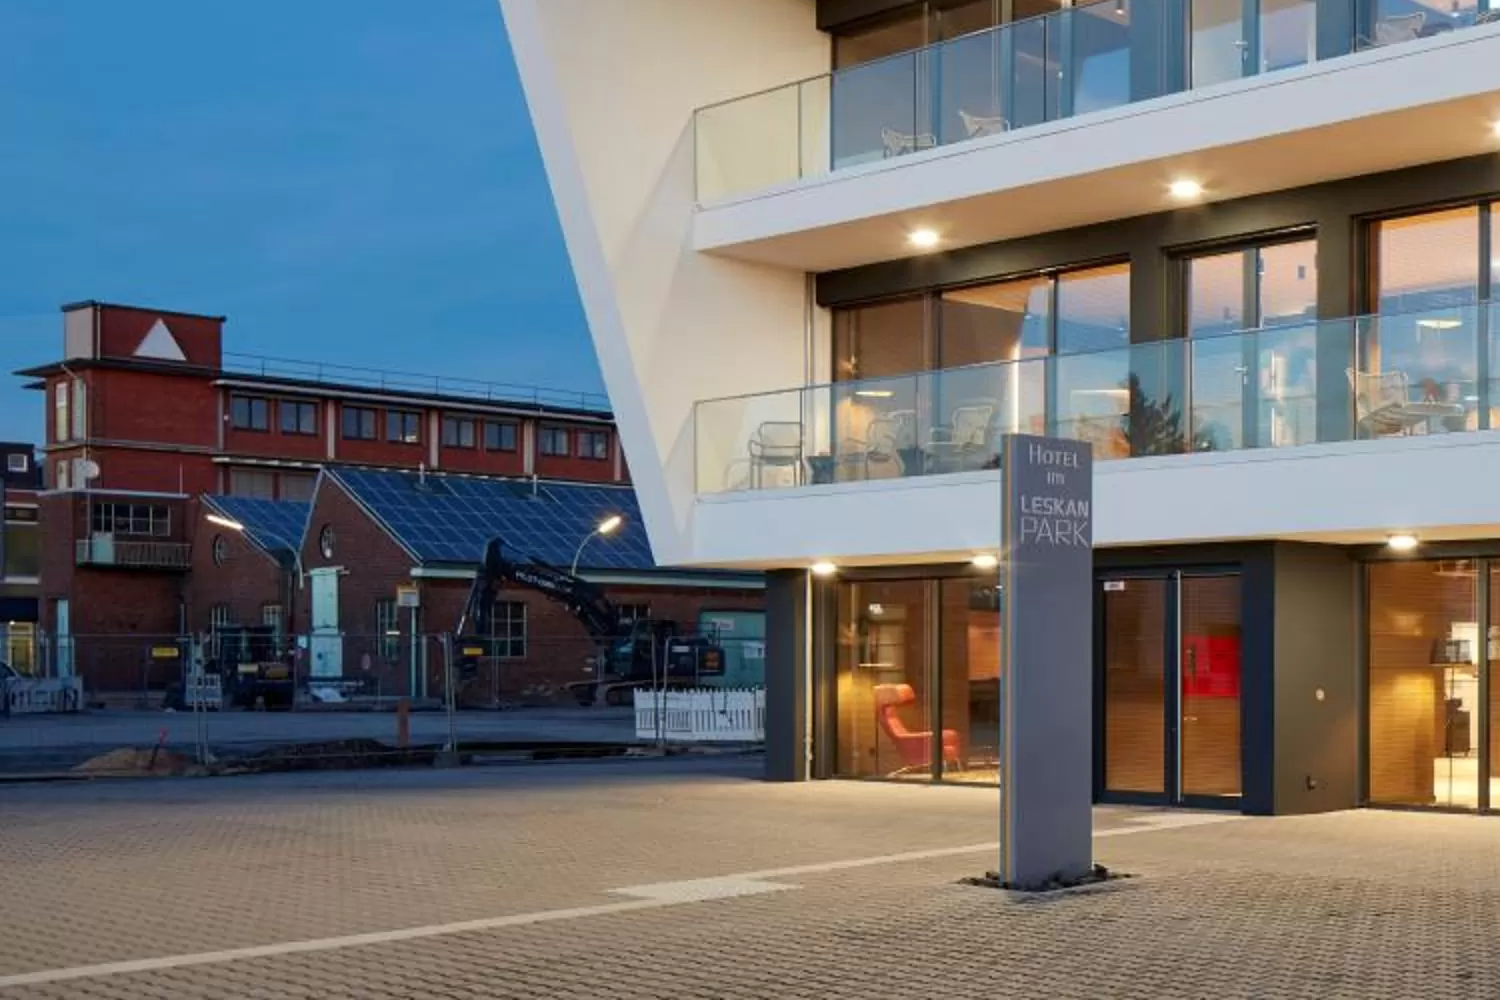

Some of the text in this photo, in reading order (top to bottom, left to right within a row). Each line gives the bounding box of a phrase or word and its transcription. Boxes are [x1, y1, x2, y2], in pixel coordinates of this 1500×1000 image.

[1047, 471, 1065, 485] im
[1021, 495, 1088, 517] LESKAN
[1021, 516, 1089, 548] PARK
